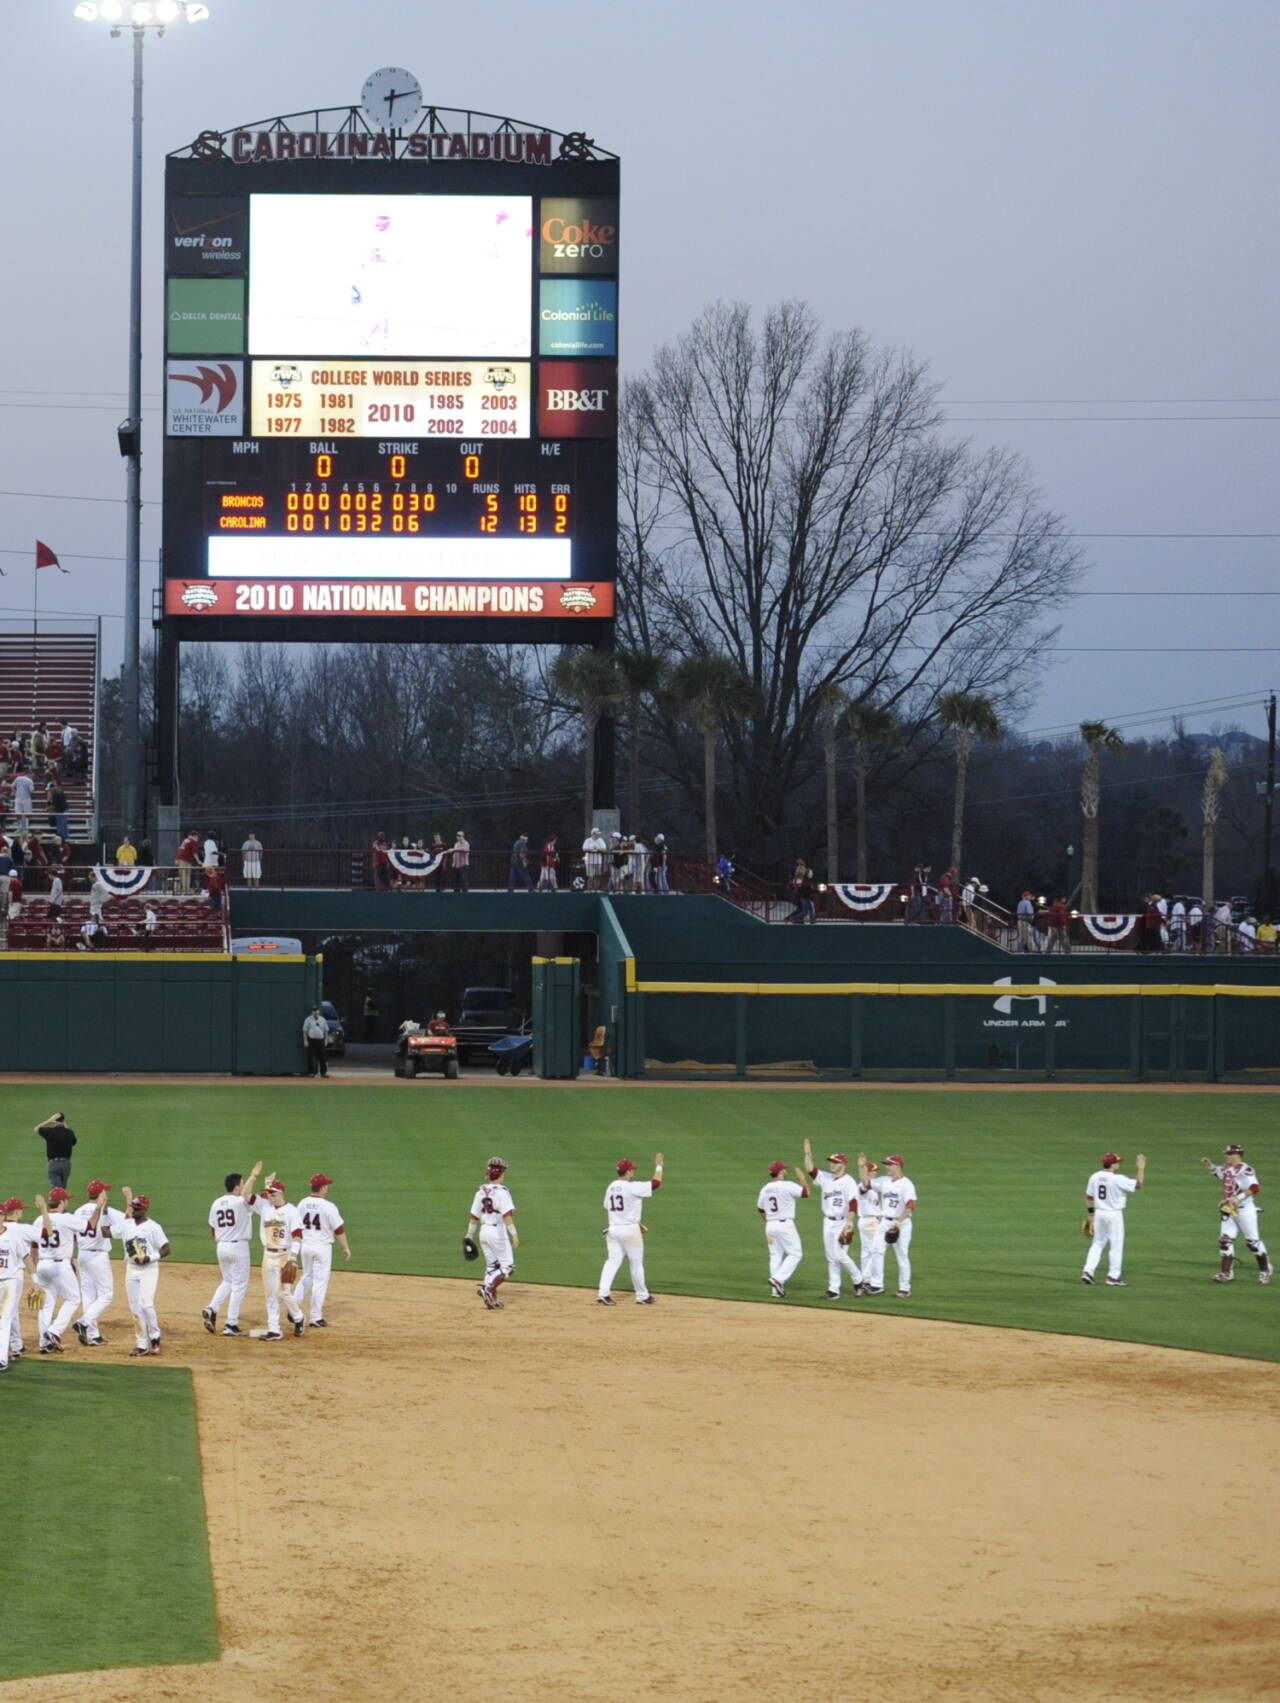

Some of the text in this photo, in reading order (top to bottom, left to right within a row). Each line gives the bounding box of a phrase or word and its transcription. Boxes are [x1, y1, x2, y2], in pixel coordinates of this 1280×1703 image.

[231, 131, 554, 166] CAROLINA STADIUM
[542, 217, 616, 244] Coke
[174, 234, 233, 248] verizon
[202, 250, 241, 260] wireless
[553, 244, 604, 258] zero
[182, 312, 242, 320] DELTA DENTAL
[541, 308, 614, 320] Colonial Life
[311, 370, 472, 386] COLLEGE WORLD SERIES
[266, 393, 302, 408] 1975
[320, 393, 354, 409] 1981
[429, 394, 464, 410] 1985
[481, 395, 517, 410] 2003
[546, 389, 609, 411] BB&T
[172, 414, 238, 424] WHITEWATER
[367, 404, 415, 422] 2010
[172, 424, 212, 433] CENTER
[266, 417, 302, 433] 1977
[320, 418, 355, 433] 1982
[428, 419, 464, 434] 2002
[481, 419, 517, 434] 2004
[232, 442, 259, 454] MPH
[309, 442, 338, 454] BALL
[378, 442, 419, 455] STRIKE
[460, 443, 484, 455] OUT
[541, 443, 561, 456] H/E
[317, 454, 332, 478] 0
[391, 455, 406, 478] 0
[465, 455, 480, 478] 0
[446, 484, 457, 494] 10
[473, 484, 500, 494] RUNS
[514, 484, 536, 494] HITS
[551, 484, 570, 494] ERR
[222, 496, 264, 508] BRONCOS
[486, 494, 498, 512] 5
[520, 494, 536, 512] 10
[555, 494, 566, 512] 0
[220, 516, 266, 528] CAROLINA
[480, 515, 498, 532] 12
[520, 515, 536, 532] 13
[555, 516, 566, 533] 2
[235, 584, 544, 612] 2010 NATIONAL CHAMPIONS
[1098, 1184, 1106, 1200] 8
[610, 1194, 624, 1212] 13
[769, 1196, 778, 1212] 3
[216, 1208, 235, 1228] 29
[302, 1212, 321, 1230] 44
[272, 1228, 284, 1238] 26
